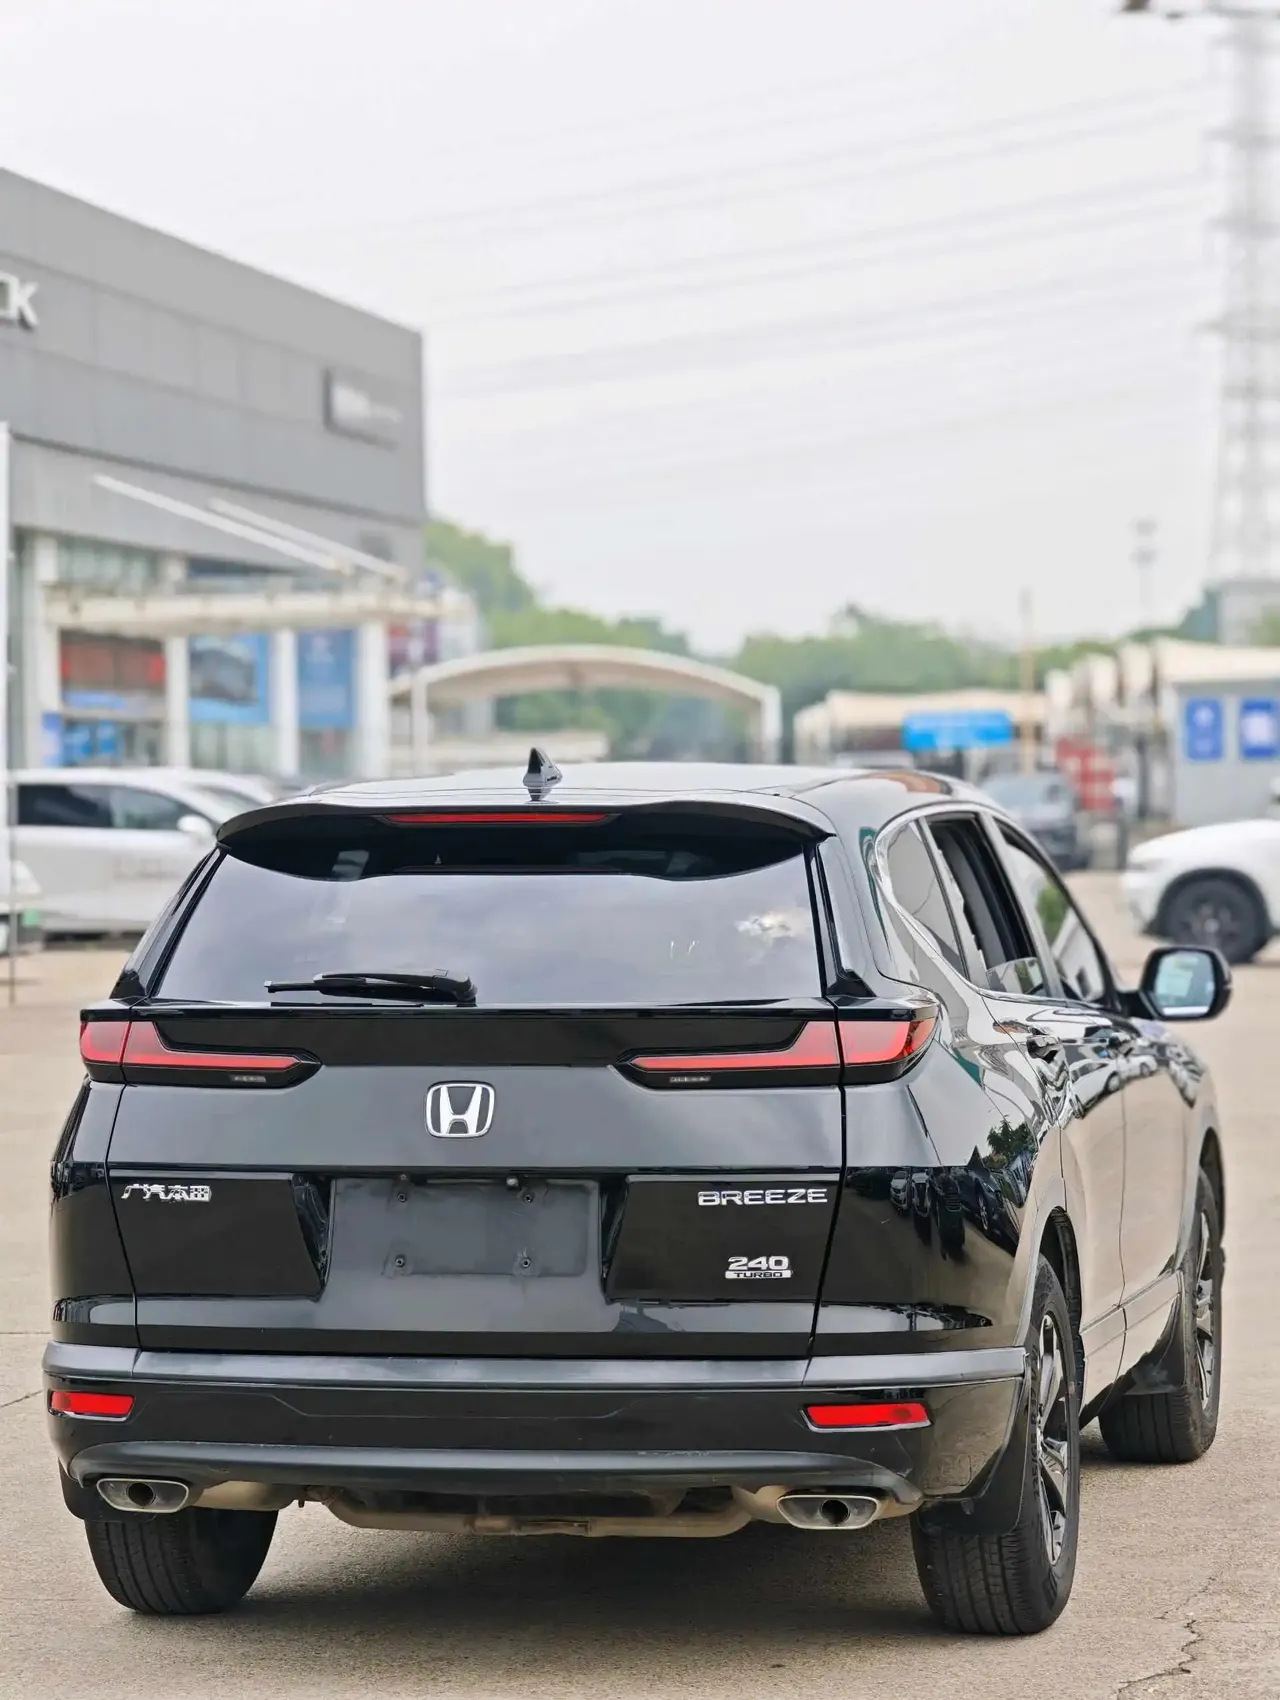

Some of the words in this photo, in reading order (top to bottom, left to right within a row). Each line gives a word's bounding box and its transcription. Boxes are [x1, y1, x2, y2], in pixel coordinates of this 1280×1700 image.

[121, 1184, 211, 1202] 广汽本田
[698, 1188, 828, 1206] BREEZE
[727, 1256, 789, 1270] 240
[733, 1271, 784, 1279] TURBO
